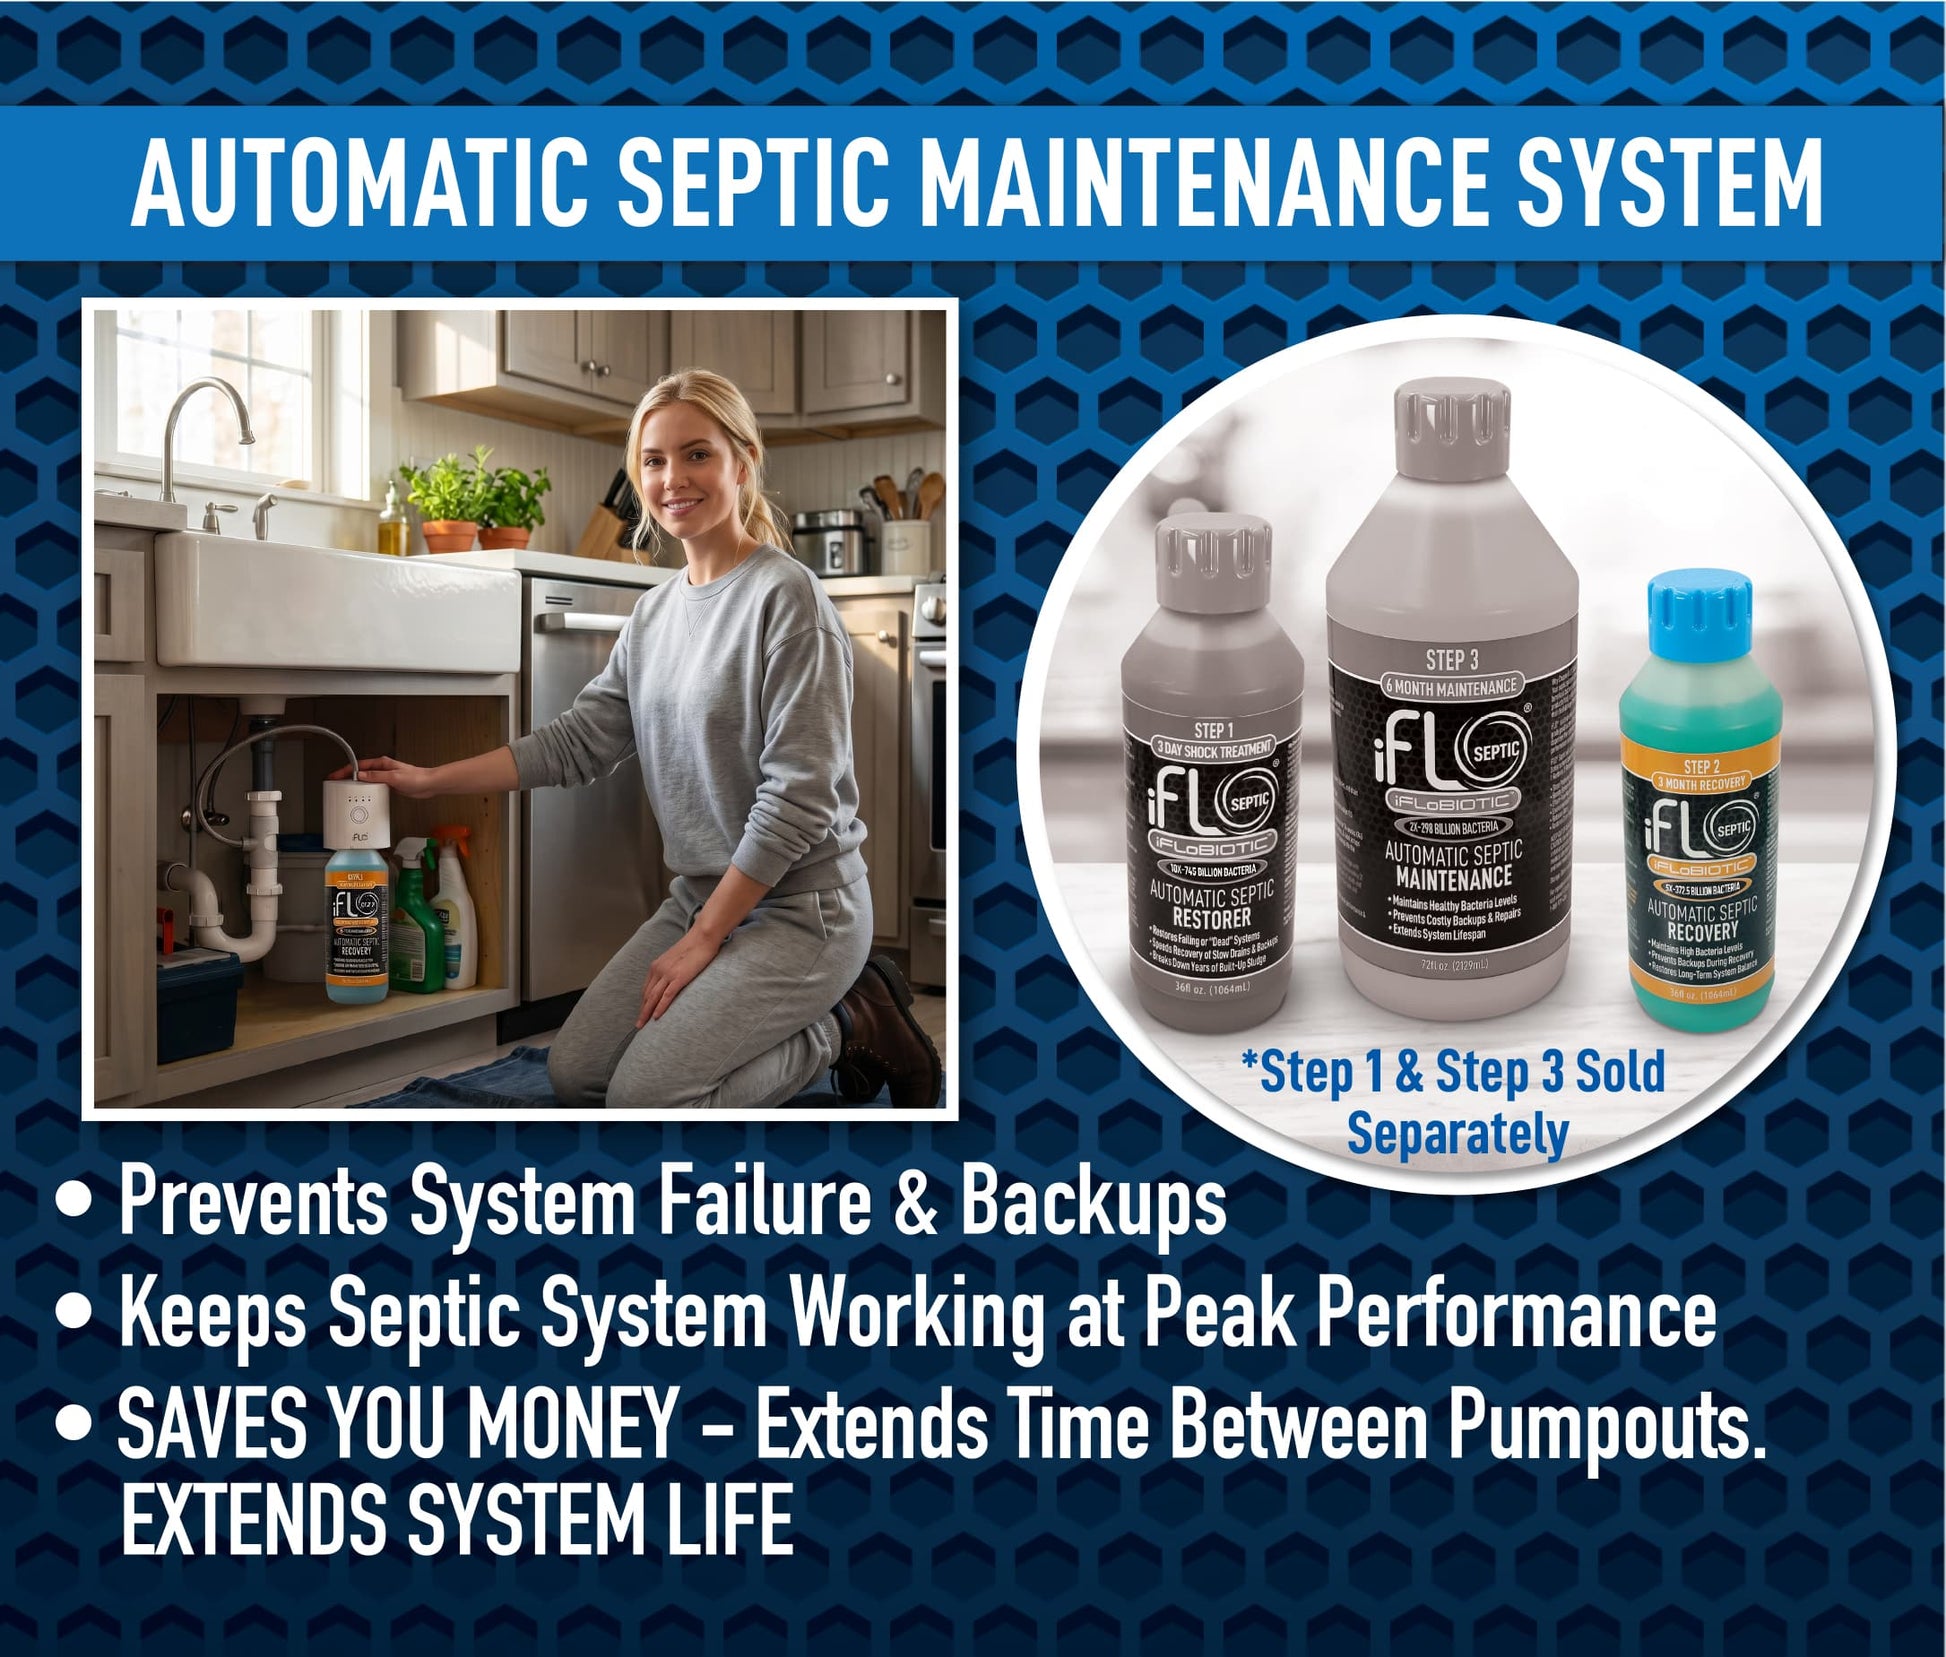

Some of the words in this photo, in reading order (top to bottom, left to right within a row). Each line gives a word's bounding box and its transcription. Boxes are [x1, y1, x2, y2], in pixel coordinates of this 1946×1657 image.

[1427, 649, 1465, 670] STEP
[1470, 649, 1478, 670] 3
[1386, 678, 1392, 692] 6
[1395, 680, 1433, 695] MONTH
[1437, 678, 1517, 697] MAINTENANCE
[1195, 723, 1224, 738] STEP
[1228, 723, 1233, 738] 1
[1158, 741, 1163, 752] 3
[1165, 742, 1182, 755] DAY
[1185, 745, 1218, 758] SHOCK
[1220, 739, 1272, 758] TREATMENT
[1474, 741, 1520, 762] SEPTIC
[1685, 760, 1710, 774] STEP
[1714, 760, 1719, 773] 2
[1659, 777, 1663, 786] 3
[1666, 779, 1697, 791] MONTH
[1700, 776, 1745, 791] RECOVERY
[1231, 792, 1269, 811] SEPTIC
[1435, 823, 1461, 835] BILLION
[1463, 820, 1498, 835] BACTERIA
[1718, 820, 1750, 837] SEPTIC
[1386, 840, 1468, 867] AUTOMATIC
[1474, 839, 1522, 866] SEPTIC
[1198, 867, 1222, 877] BILLION
[1224, 864, 1256, 877] BACTERIA
[1397, 864, 1512, 891] MAINTENANCE
[1150, 879, 1226, 908] AUTOMATIC
[1231, 879, 1274, 906] SEPTIC
[1691, 887, 1712, 896] BILLION
[1713, 882, 1740, 895] BACTERIA
[1393, 894, 1428, 910] Maintains
[1430, 900, 1459, 913] Healthy
[1461, 898, 1493, 911] Bacteria
[1495, 894, 1517, 907] Levels
[1648, 898, 1715, 922] AUTOMATIC
[1720, 895, 1758, 920] SEPTIC
[1173, 906, 1251, 930] RESTORER
[1393, 909, 1425, 924] Prevents
[1427, 914, 1451, 927] Costly
[1453, 914, 1486, 927] Backups
[1488, 912, 1493, 922] &
[1495, 908, 1521, 922] Repairs
[1393, 924, 1422, 938] Extends
[1423, 928, 1452, 941] System
[1454, 930, 1486, 942] Lifespan
[1668, 920, 1738, 942] RECOVERY
[1179, 934, 1199, 947] Failing
[342, 947, 371, 955] RECOVERY
[1173, 945, 1202, 960] Recovery
[1213, 950, 1229, 959] Slow
[1231, 947, 1250, 958] Drains
[1680, 947, 1694, 957] High
[1696, 946, 1722, 956] Bacteria
[1724, 943, 1743, 953] Levels
[1173, 959, 1190, 970] Down
[1191, 962, 1209, 972] Years
[1678, 958, 1705, 968] Backups
[1707, 958, 1727, 968] During
[1714, 967, 1736, 979] System
